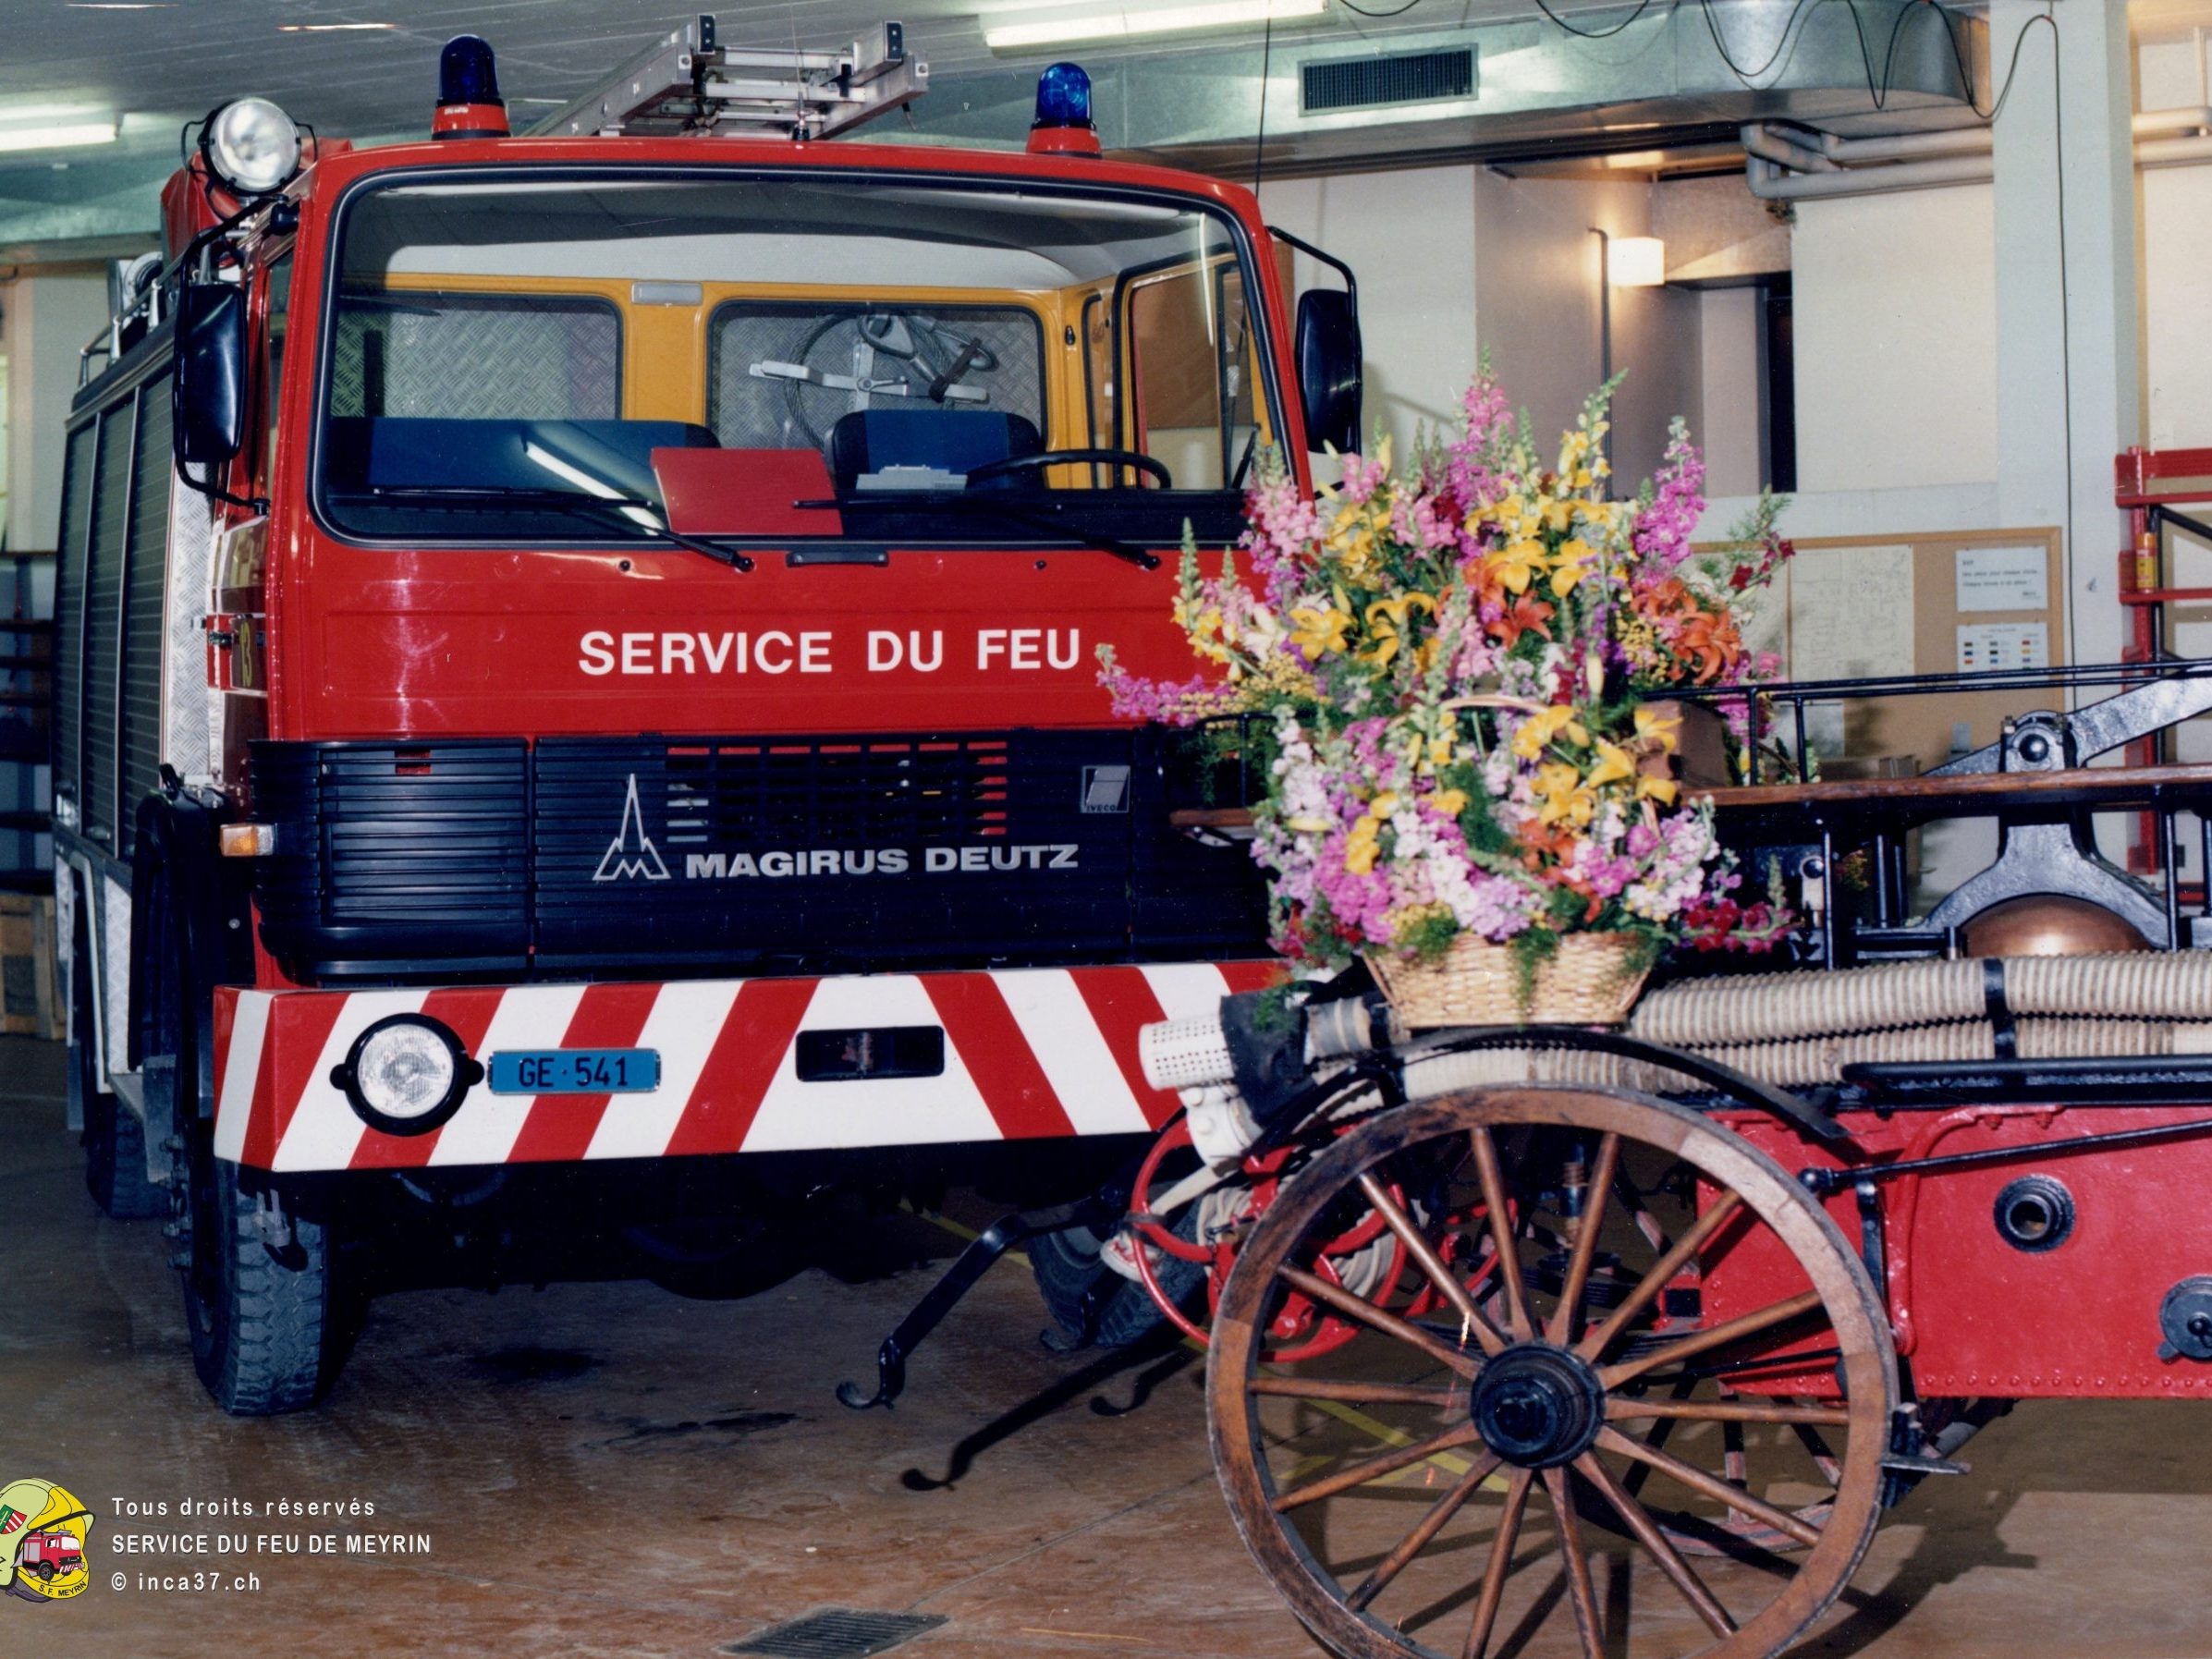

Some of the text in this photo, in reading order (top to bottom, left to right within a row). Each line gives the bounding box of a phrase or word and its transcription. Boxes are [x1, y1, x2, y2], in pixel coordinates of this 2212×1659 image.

[579, 628, 1081, 676] SERVICE DU FEU
[686, 844, 1080, 879] MAGIRUS DEUTZ
[519, 1055, 629, 1088] GE 541
